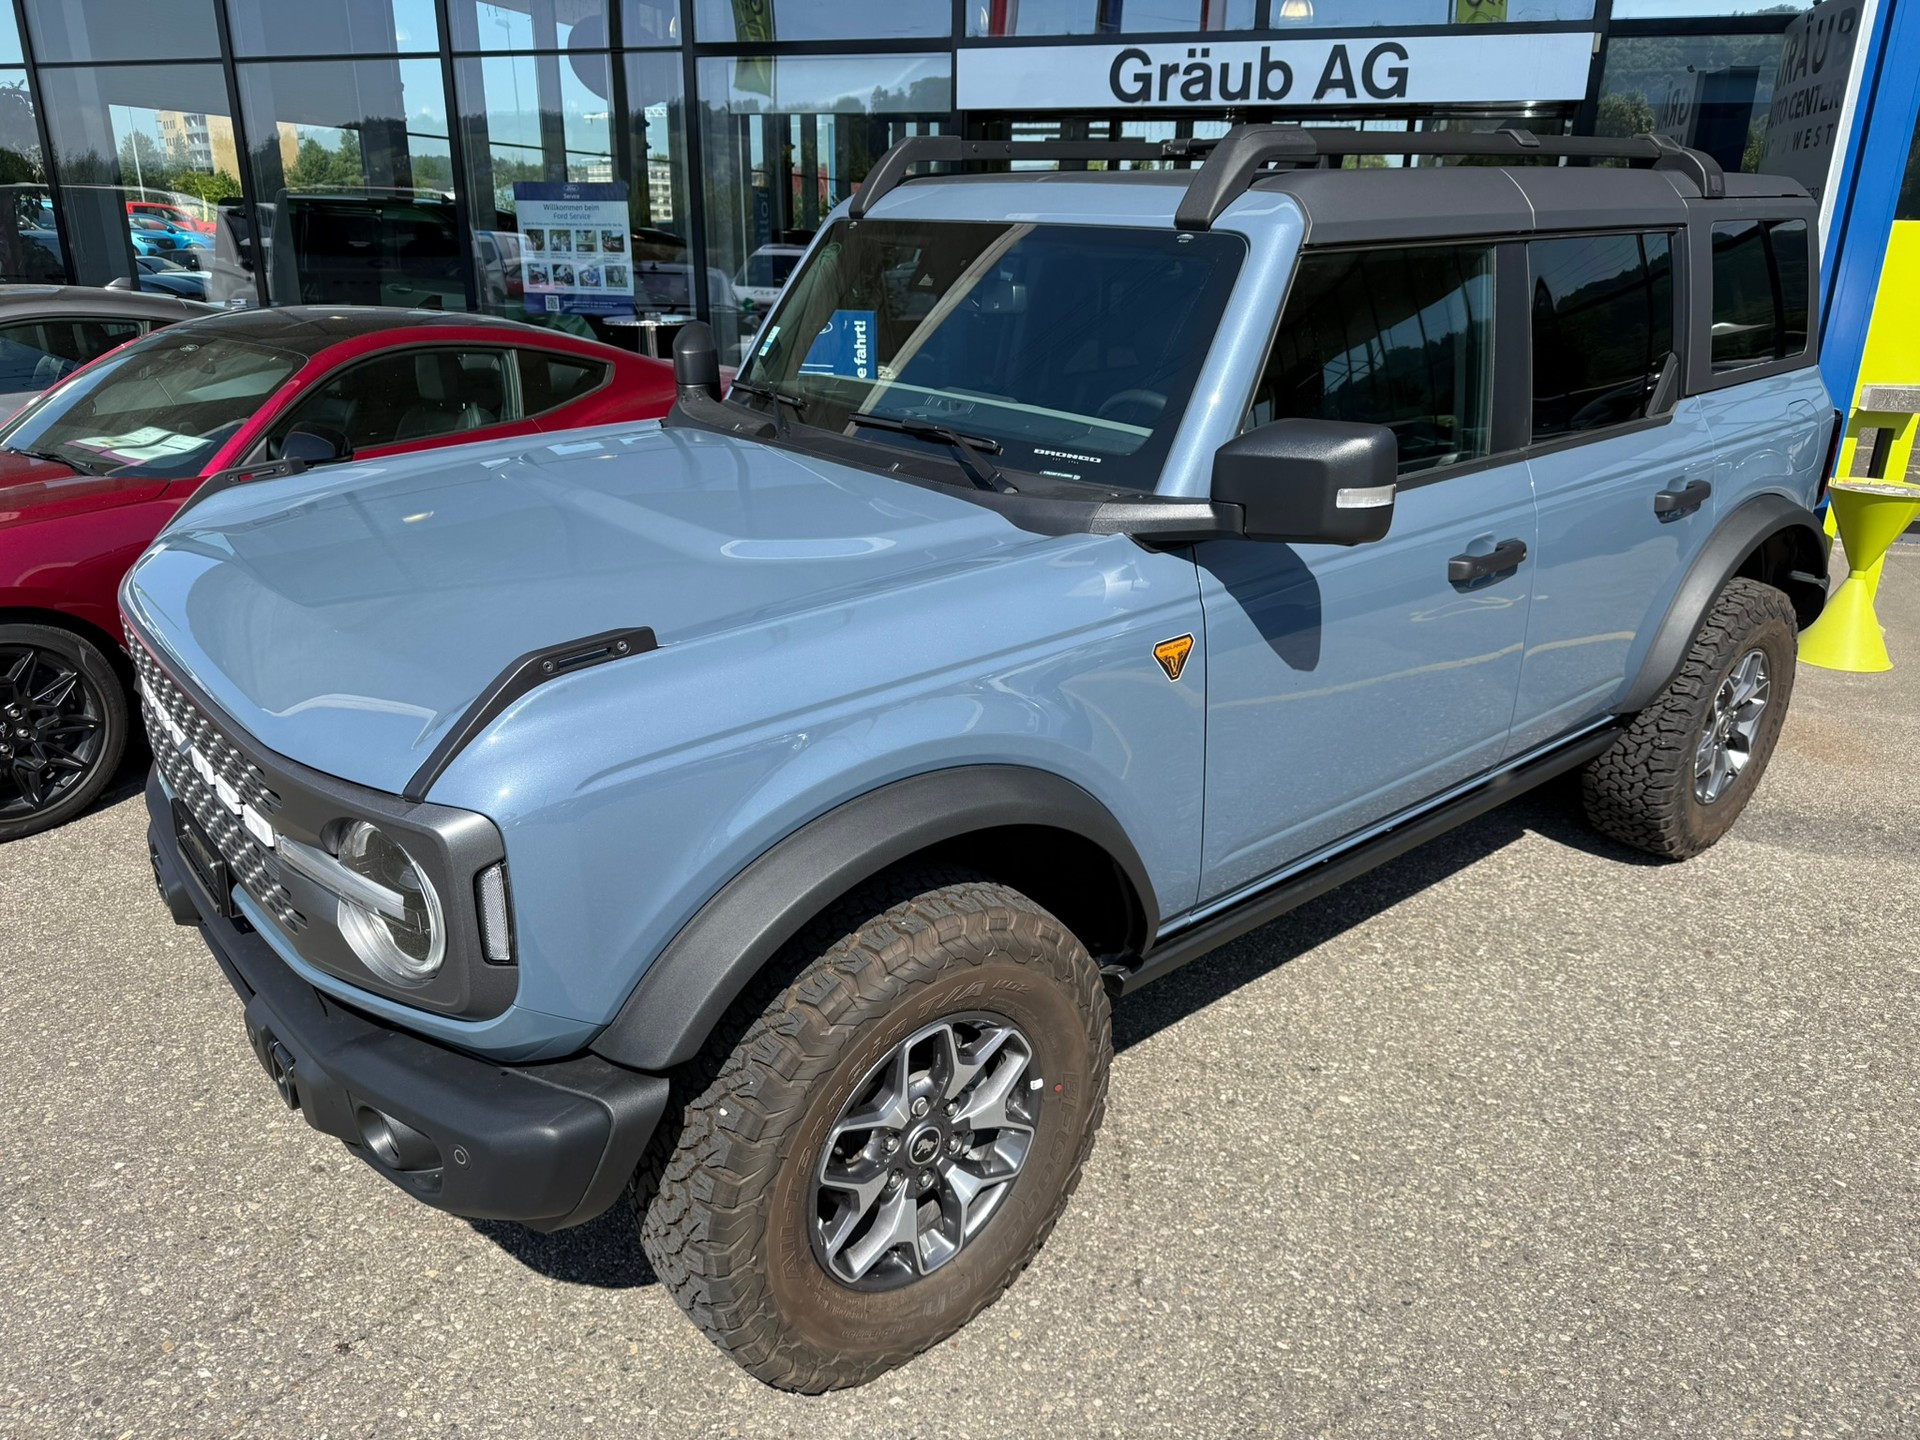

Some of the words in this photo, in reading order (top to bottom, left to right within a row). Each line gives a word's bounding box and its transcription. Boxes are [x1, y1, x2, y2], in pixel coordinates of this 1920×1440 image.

[1109, 46, 1293, 103] Gräub
[1313, 42, 1409, 101] AG
[1792, 122, 1834, 152] WEST
[543, 203, 584, 211] Willkommen
[584, 203, 600, 211] beim
